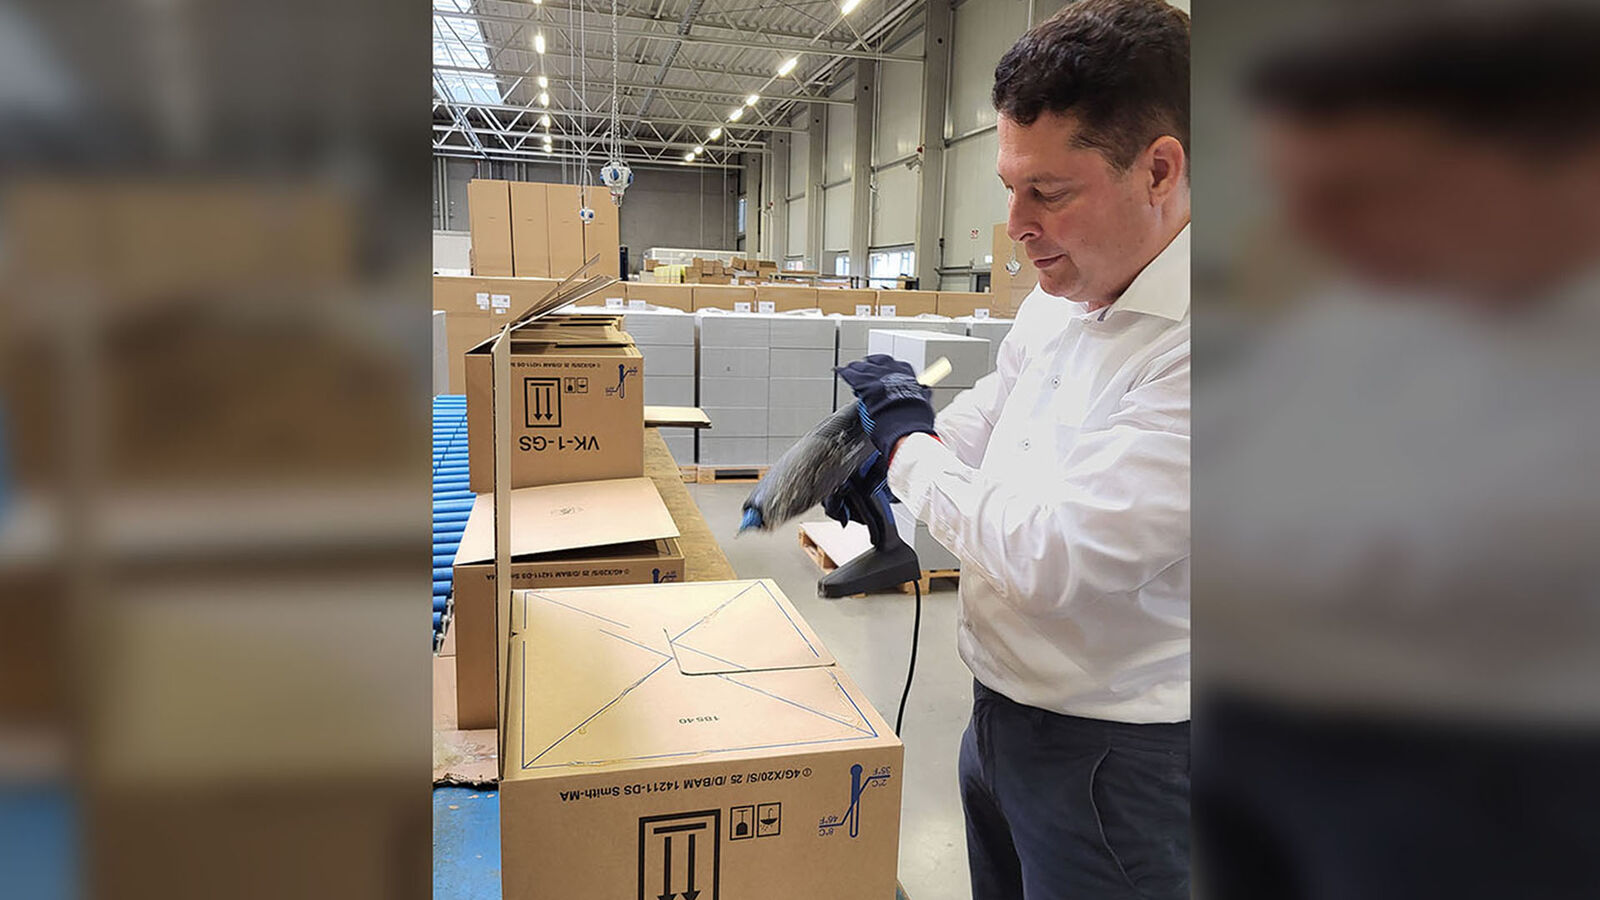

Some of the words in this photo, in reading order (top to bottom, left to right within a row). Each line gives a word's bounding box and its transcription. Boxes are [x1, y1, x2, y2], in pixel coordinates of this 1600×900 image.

[519, 436, 600, 451] VK-1-GS
[678, 715, 720, 725] 18540
[684, 776, 727, 790] /D/BAM
[730, 774, 743, 785] 25
[746, 769, 800, 783] 4G/X20/S/
[559, 786, 620, 801] Smith-MA
[624, 780, 680, 796] 14211-DS
